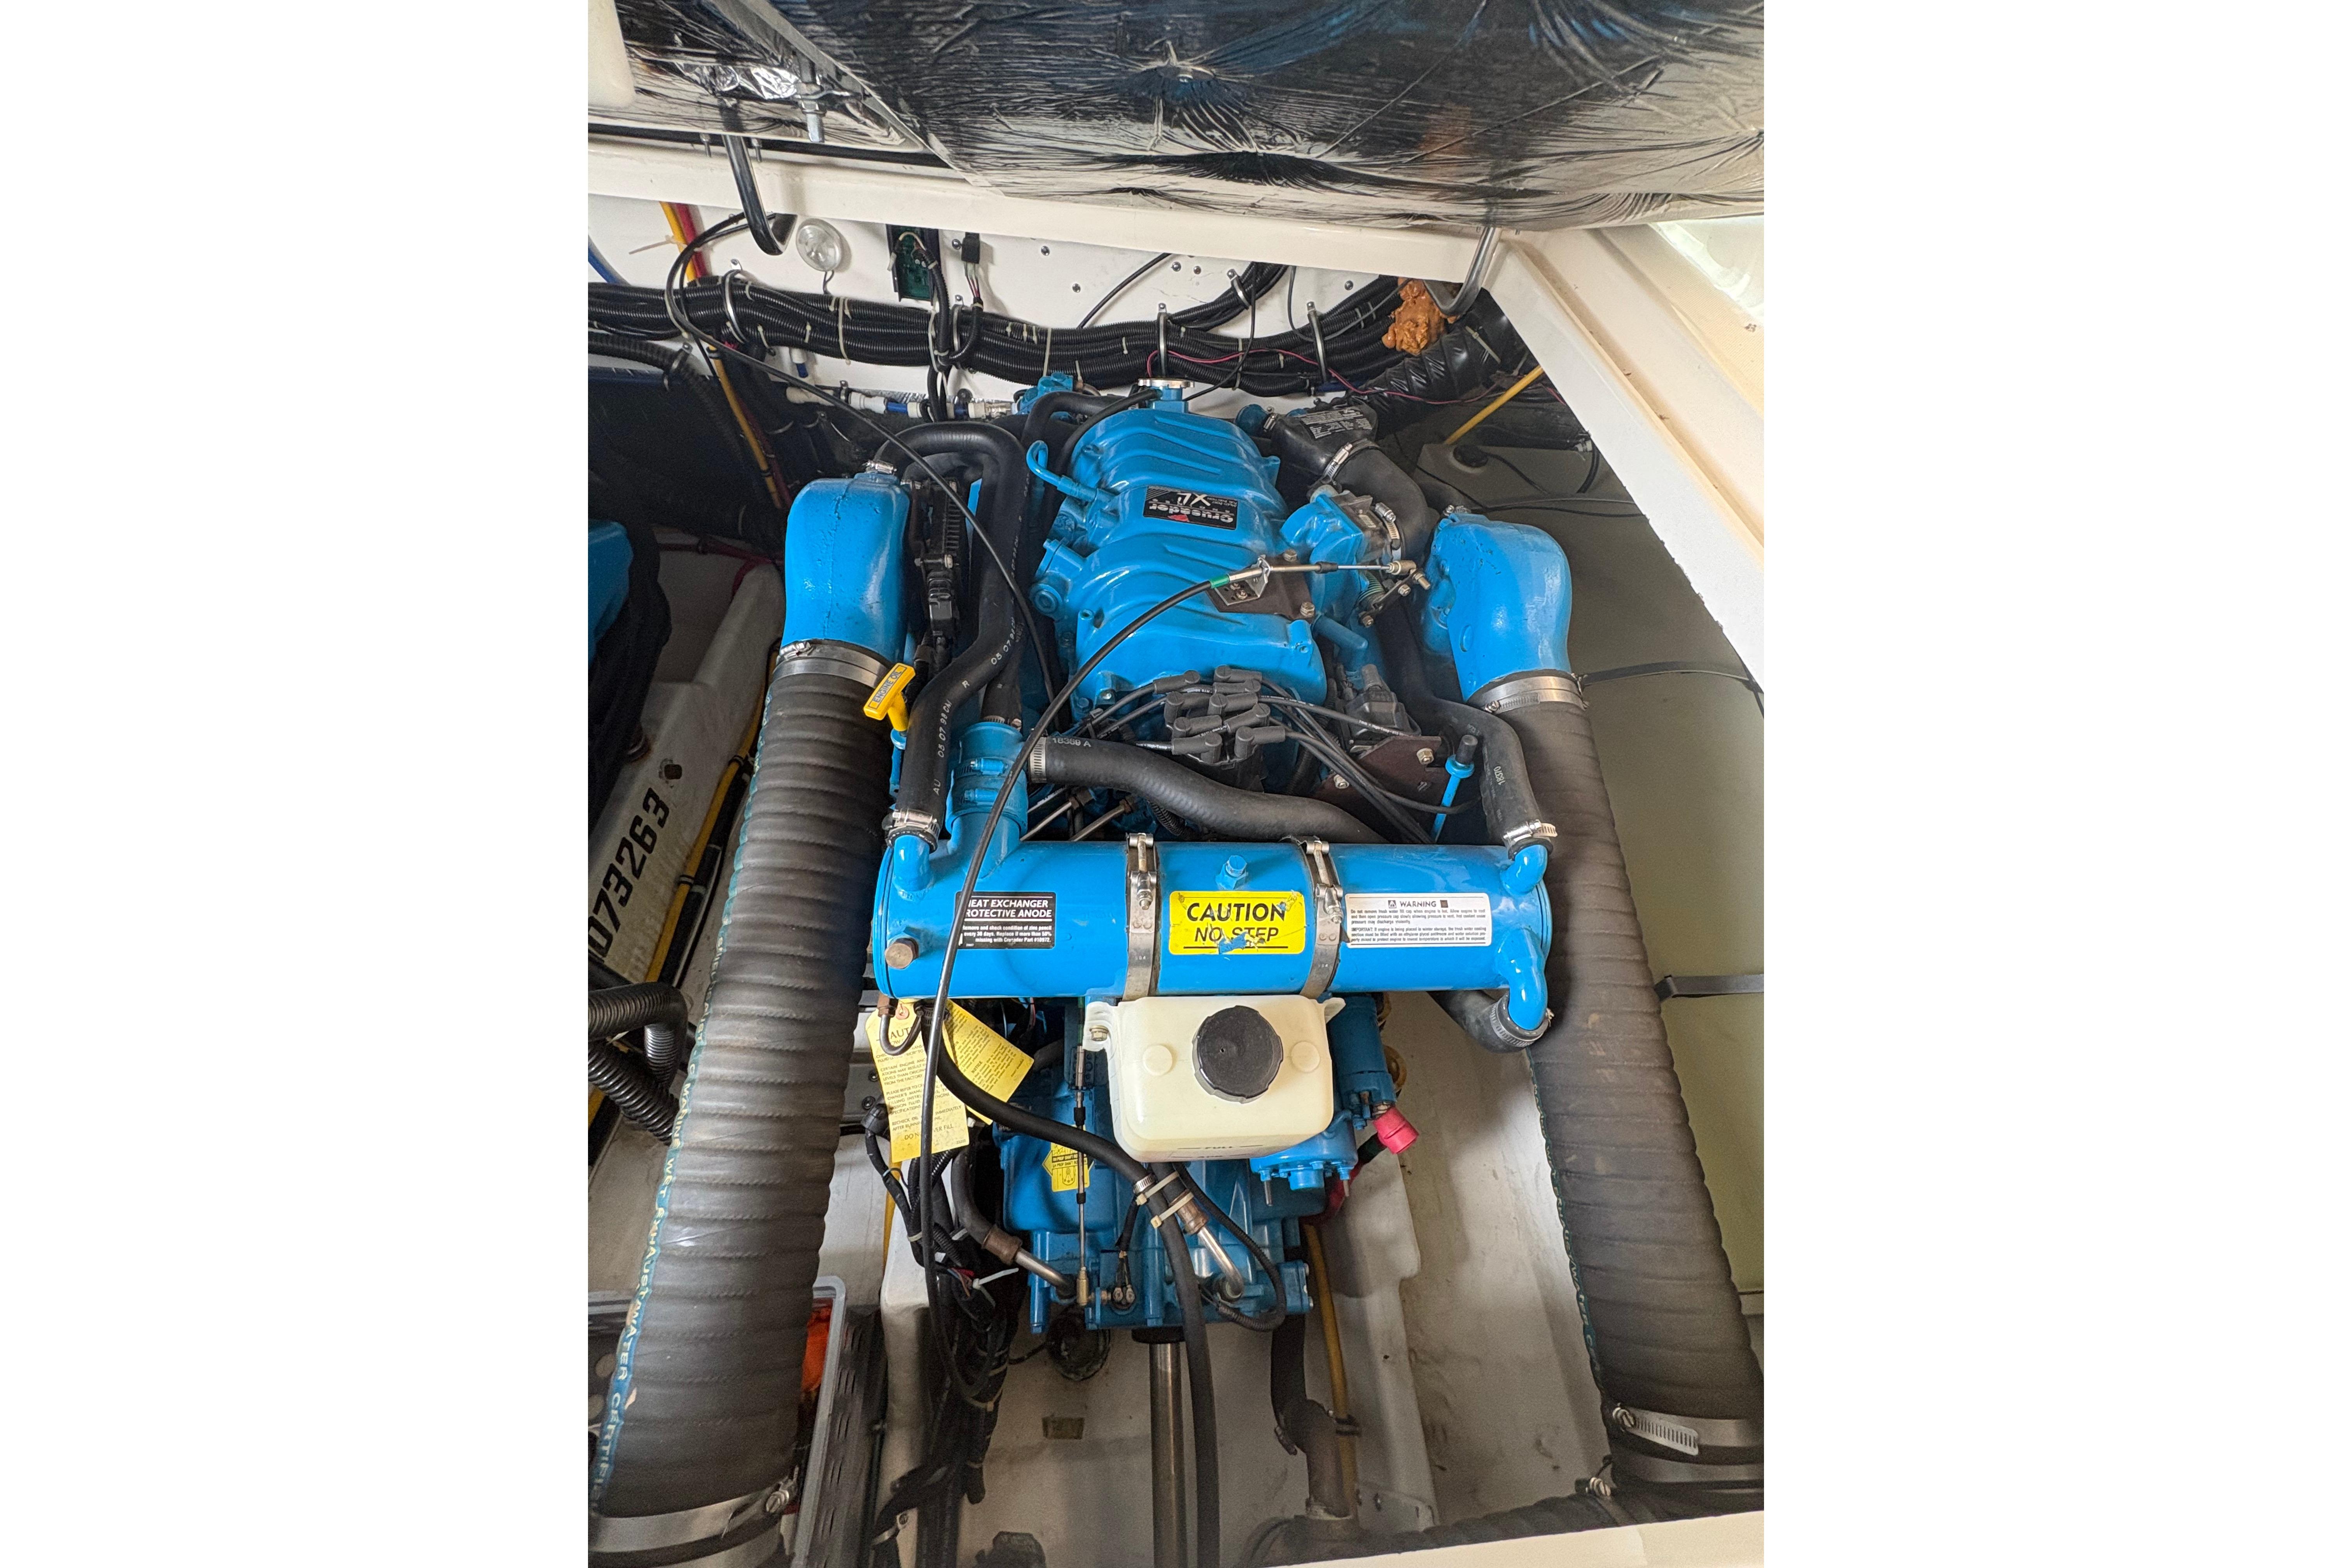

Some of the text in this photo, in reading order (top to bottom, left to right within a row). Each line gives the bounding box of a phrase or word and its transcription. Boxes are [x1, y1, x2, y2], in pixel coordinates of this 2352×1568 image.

[1149, 504, 1234, 523] Crusader
[872, 671, 903, 703] ENGINE OIL
[962, 680, 970, 689] R
[939, 726, 946, 741] 07
[937, 744, 945, 758] 05
[1494, 766, 1506, 786] 18370
[968, 899, 1048, 908] EAT EXCHANGER
[1186, 902, 1286, 922] CAUTION
[966, 909, 1052, 917] ROTECTIVE ANODE
[1194, 927, 1222, 942] NO
[672, 1082, 691, 1150] MARINE
[659, 1158, 674, 1198] WET
